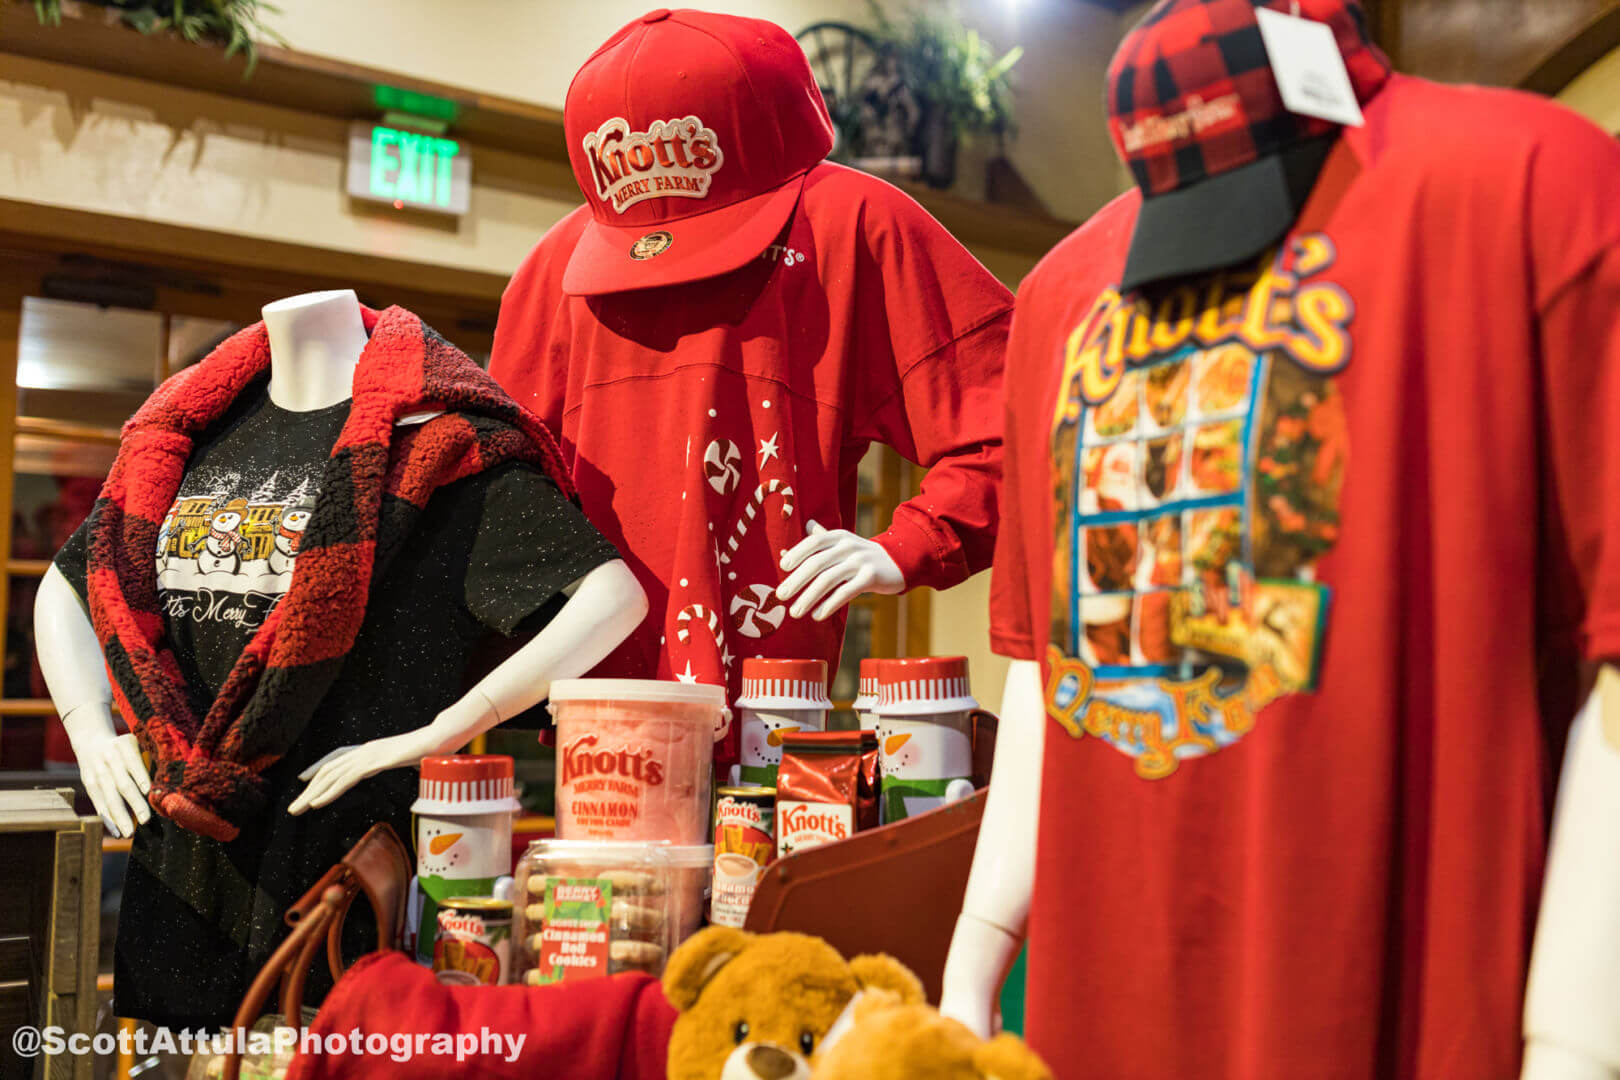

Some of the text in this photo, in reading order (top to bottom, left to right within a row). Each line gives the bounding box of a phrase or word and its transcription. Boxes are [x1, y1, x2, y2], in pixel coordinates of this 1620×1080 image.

[369, 126, 459, 207] EXIT
[588, 123, 718, 194] Knott's
[613, 178, 650, 208] MERRY
[193, 587, 259, 629] Merry
[562, 735, 664, 787] Knott's
[572, 801, 639, 818] CINNAMON
[718, 799, 761, 823] Knott's
[782, 804, 846, 840] Knott's
[543, 929, 606, 944] Cinnamon
[561, 941, 587, 954] Roll
[548, 952, 597, 968] Cookies
